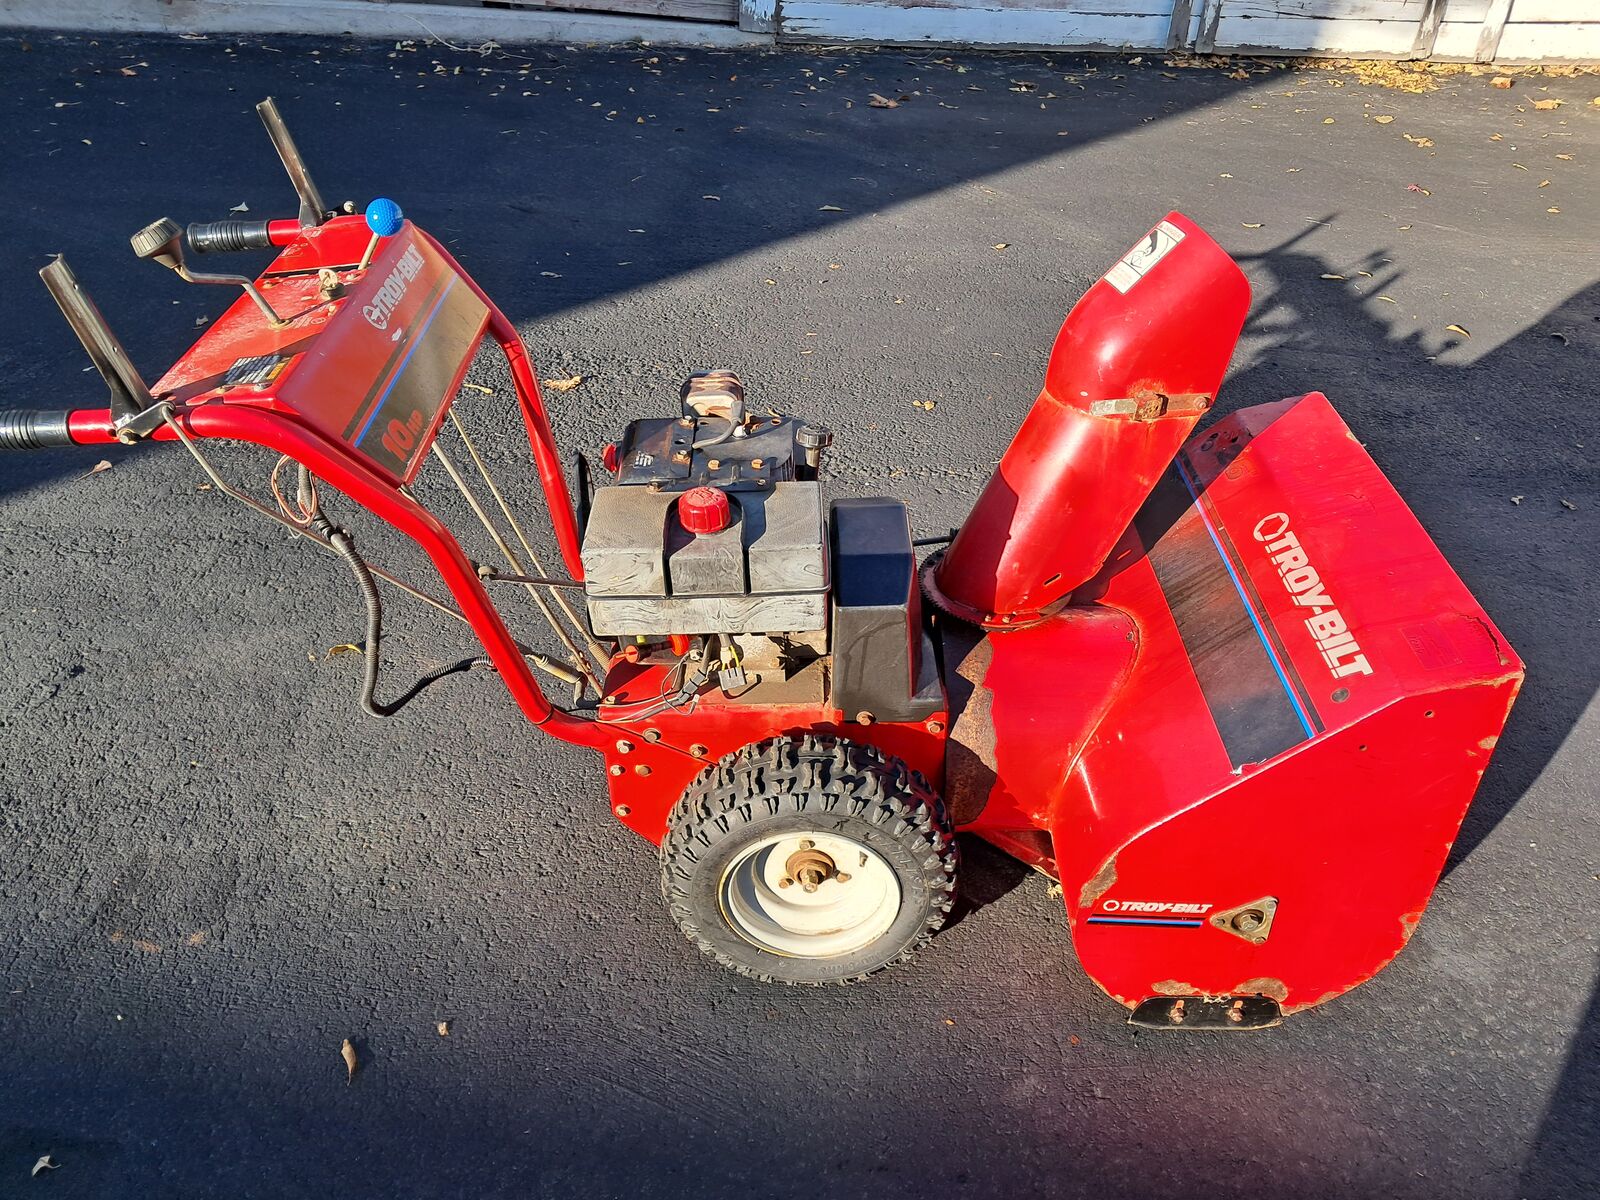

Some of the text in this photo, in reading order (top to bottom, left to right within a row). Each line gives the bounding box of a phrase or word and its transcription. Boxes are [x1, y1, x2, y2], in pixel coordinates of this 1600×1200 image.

[372, 243, 424, 320] TROY-BILT
[1265, 531, 1373, 679] TROY-BILT
[1120, 901, 1213, 913] TROY-BILT
